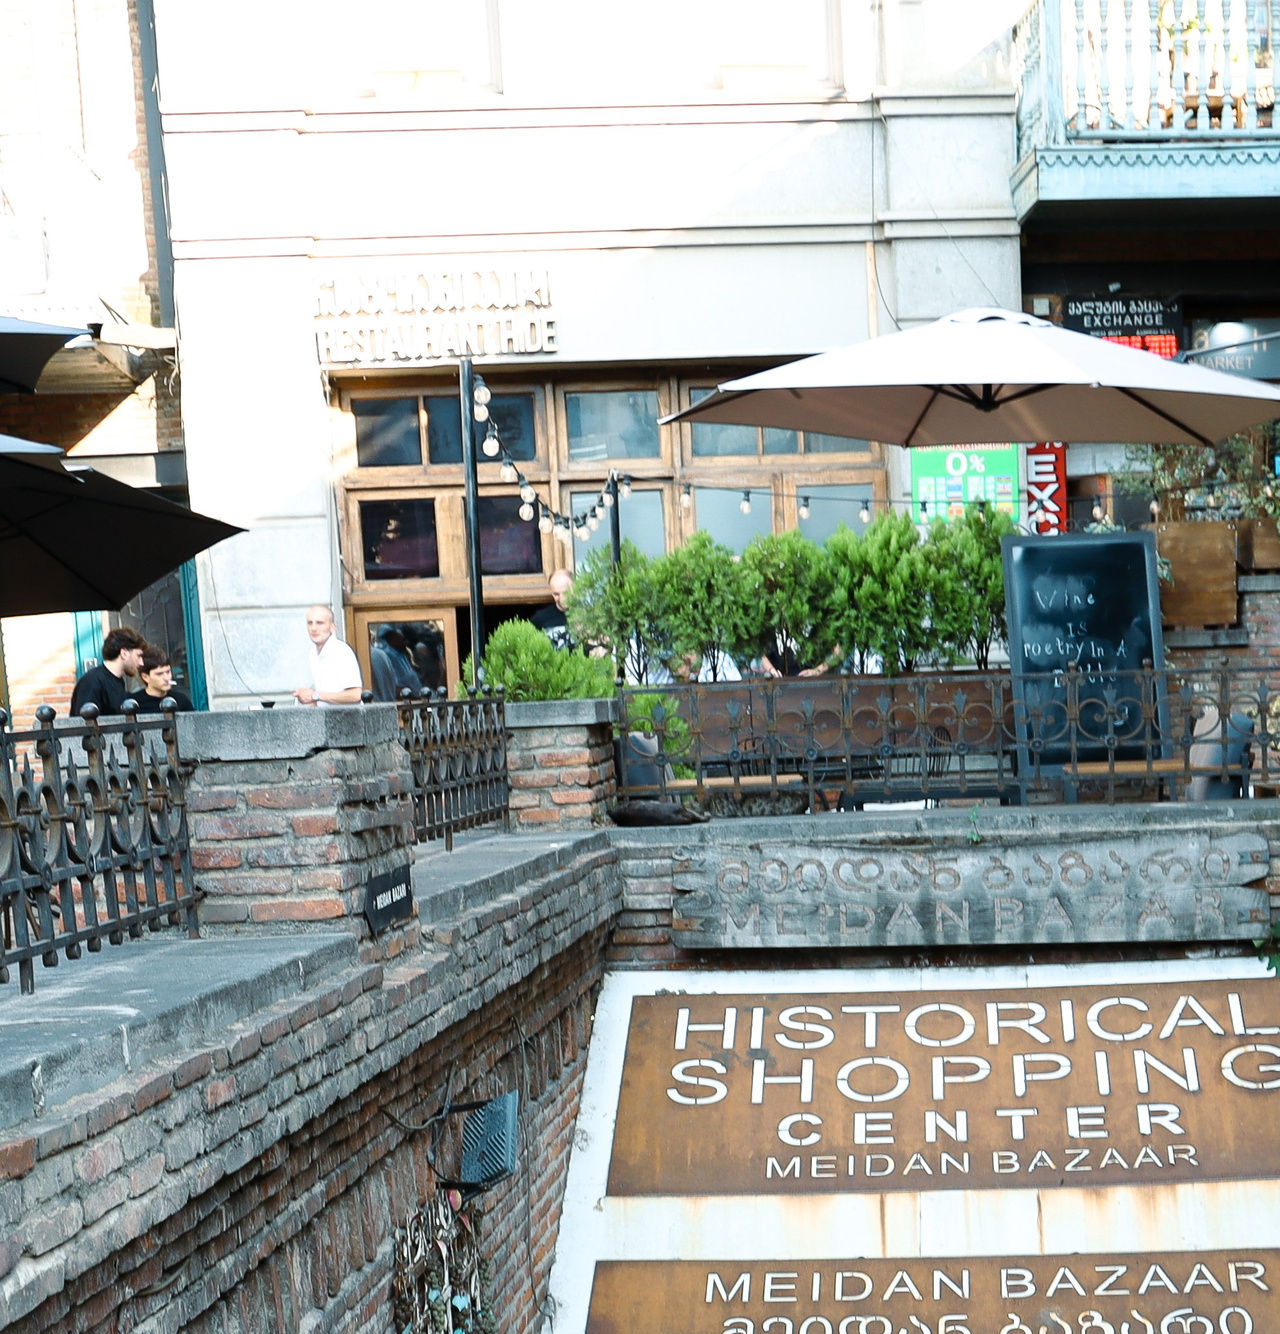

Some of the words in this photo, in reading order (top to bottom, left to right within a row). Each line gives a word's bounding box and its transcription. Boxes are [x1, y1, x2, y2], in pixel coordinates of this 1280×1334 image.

[1129, 300, 1178, 314] გაცვა
[1083, 314, 1163, 328] EXCHANGE
[1036, 590, 1096, 609] Wine
[1116, 639, 1127, 657] A
[720, 899, 970, 935] MEIDAN
[994, 891, 1226, 930] BAZAR
[777, 1103, 1186, 1147] CENTER
[766, 1152, 970, 1179] MEIDAN
[992, 1144, 1199, 1174] BAZAAR
[705, 1268, 971, 1303] MEIDAN
[1000, 1261, 1270, 1299] BAZAAR
